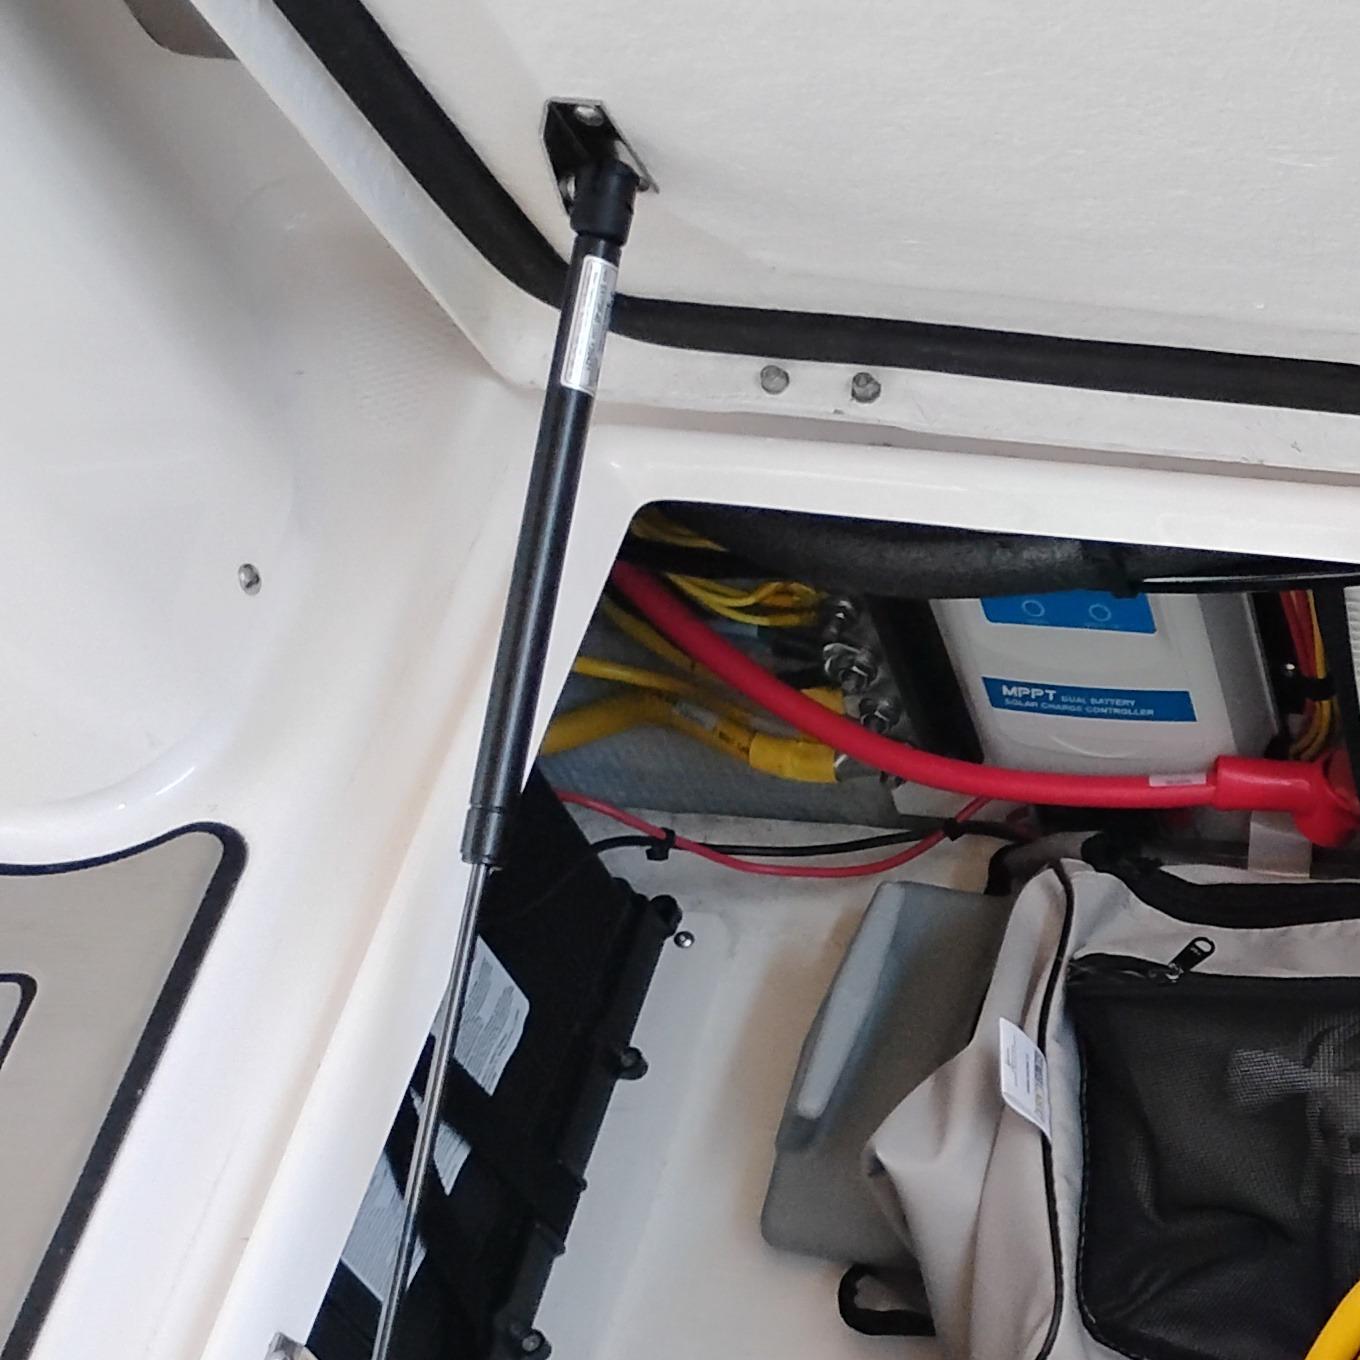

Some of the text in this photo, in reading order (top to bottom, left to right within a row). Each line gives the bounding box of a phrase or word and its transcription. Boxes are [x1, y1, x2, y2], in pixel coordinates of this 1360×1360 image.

[1001, 684, 1057, 701] MPPT
[1090, 696, 1136, 707] BATTERY
[1004, 698, 1155, 716] SOLAR CHARGE CONTROLLER
